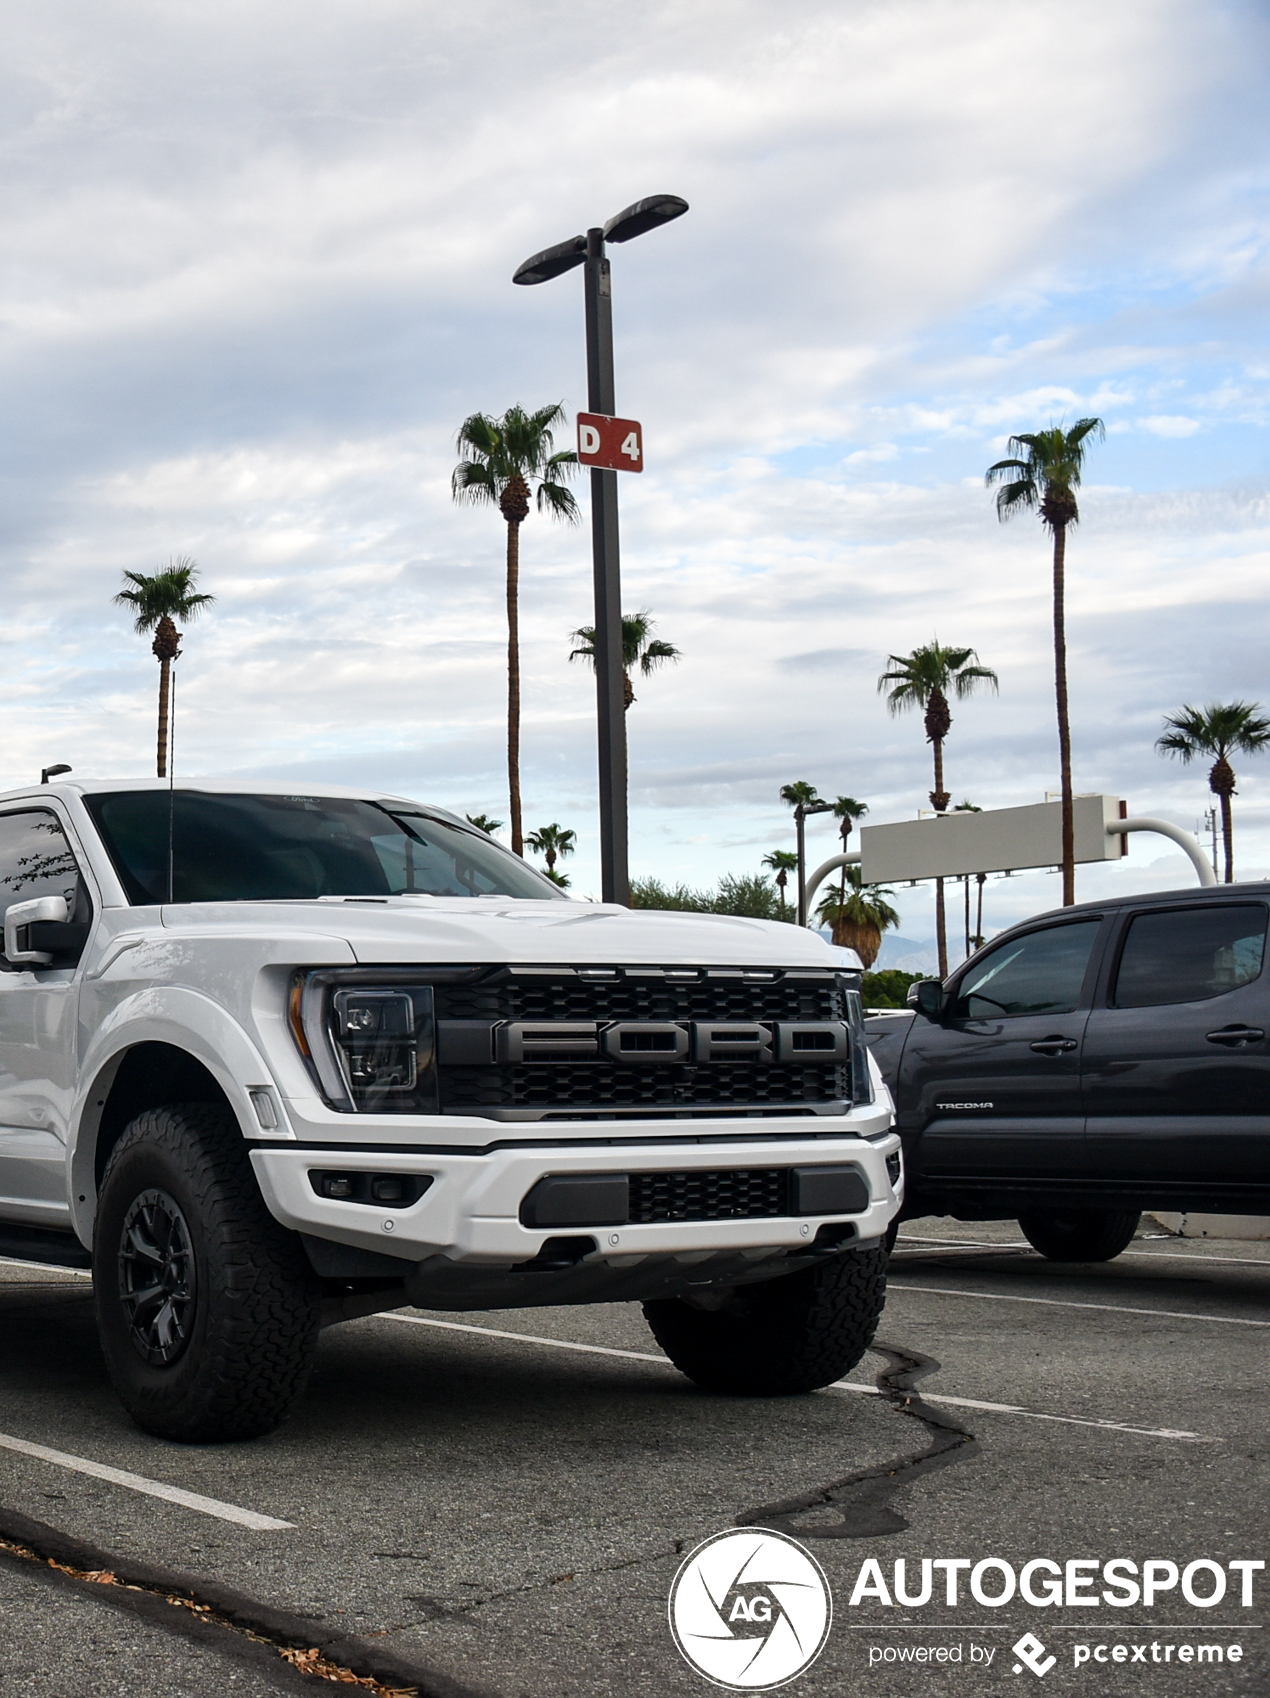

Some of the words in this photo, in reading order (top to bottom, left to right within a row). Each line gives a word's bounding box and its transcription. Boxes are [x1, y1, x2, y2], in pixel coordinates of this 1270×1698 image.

[579, 424, 600, 454] D
[621, 431, 640, 461] 4
[506, 1020, 850, 1064] FORD
